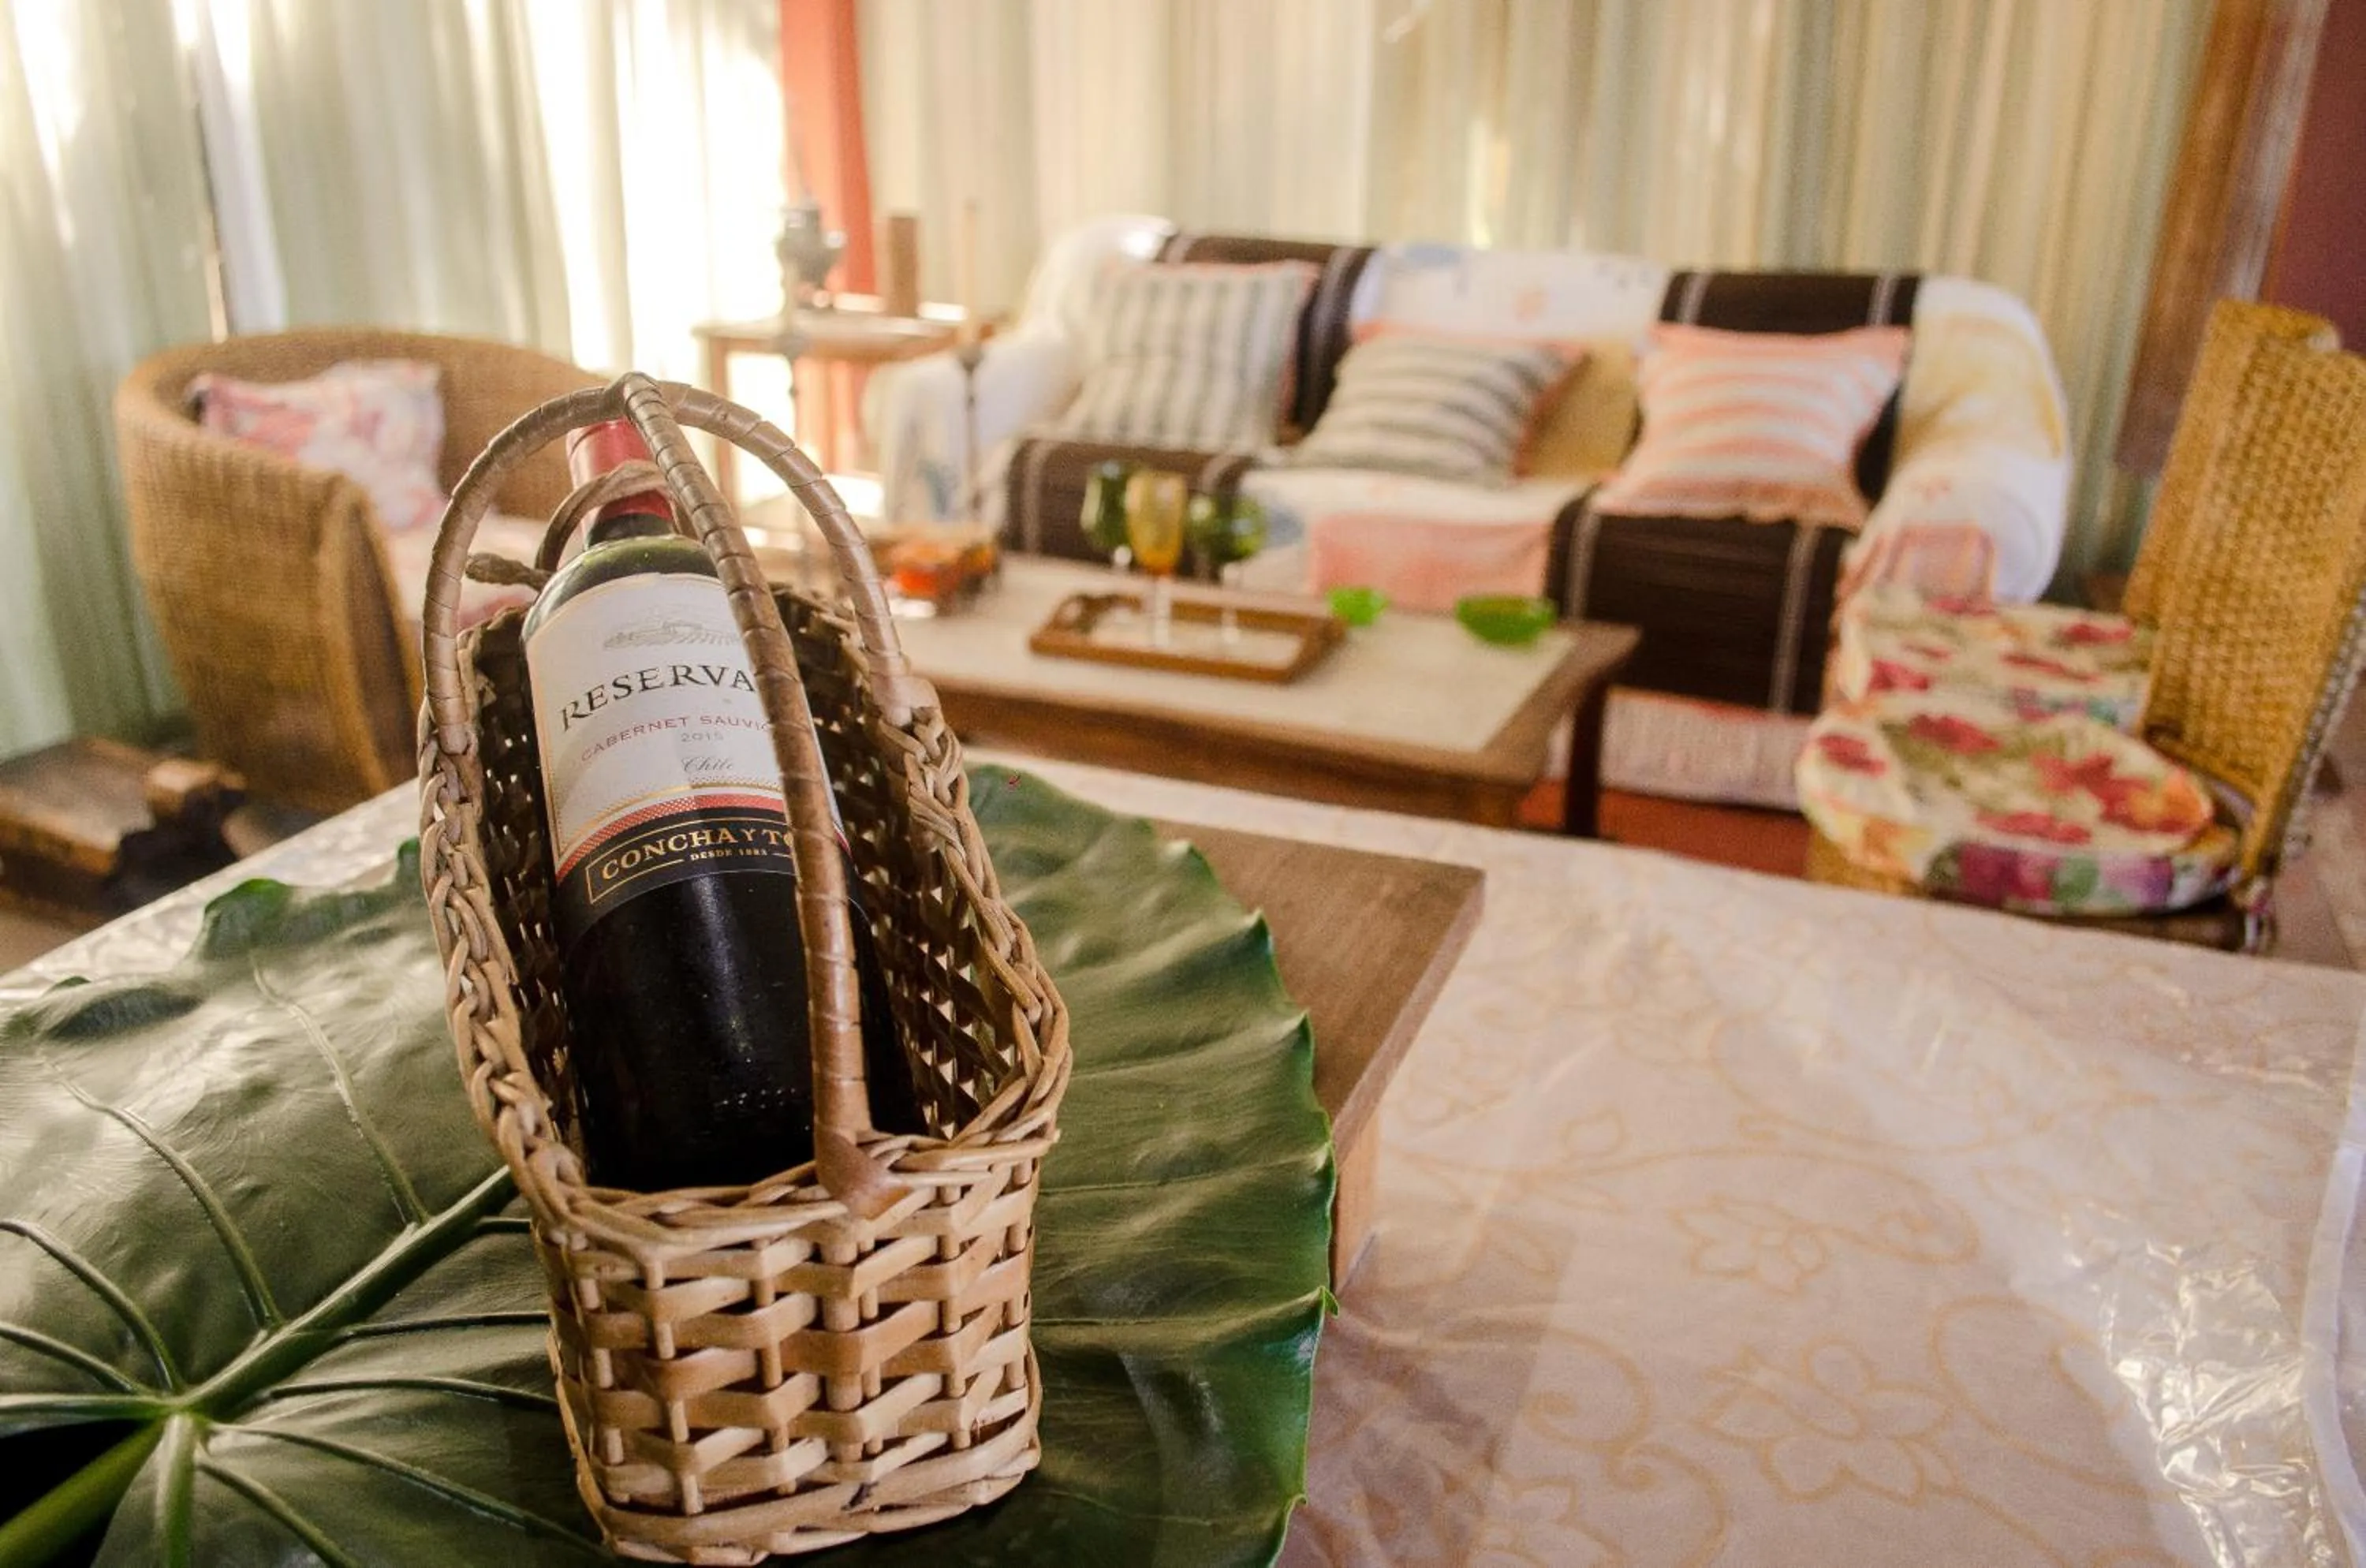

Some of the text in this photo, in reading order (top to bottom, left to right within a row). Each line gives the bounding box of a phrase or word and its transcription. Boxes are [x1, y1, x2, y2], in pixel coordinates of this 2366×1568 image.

[558, 663, 756, 733] RESERVA
[580, 715, 691, 762] CABERNET
[602, 827, 794, 879] CONCHA Y TO
[689, 849, 733, 861] DESDE
